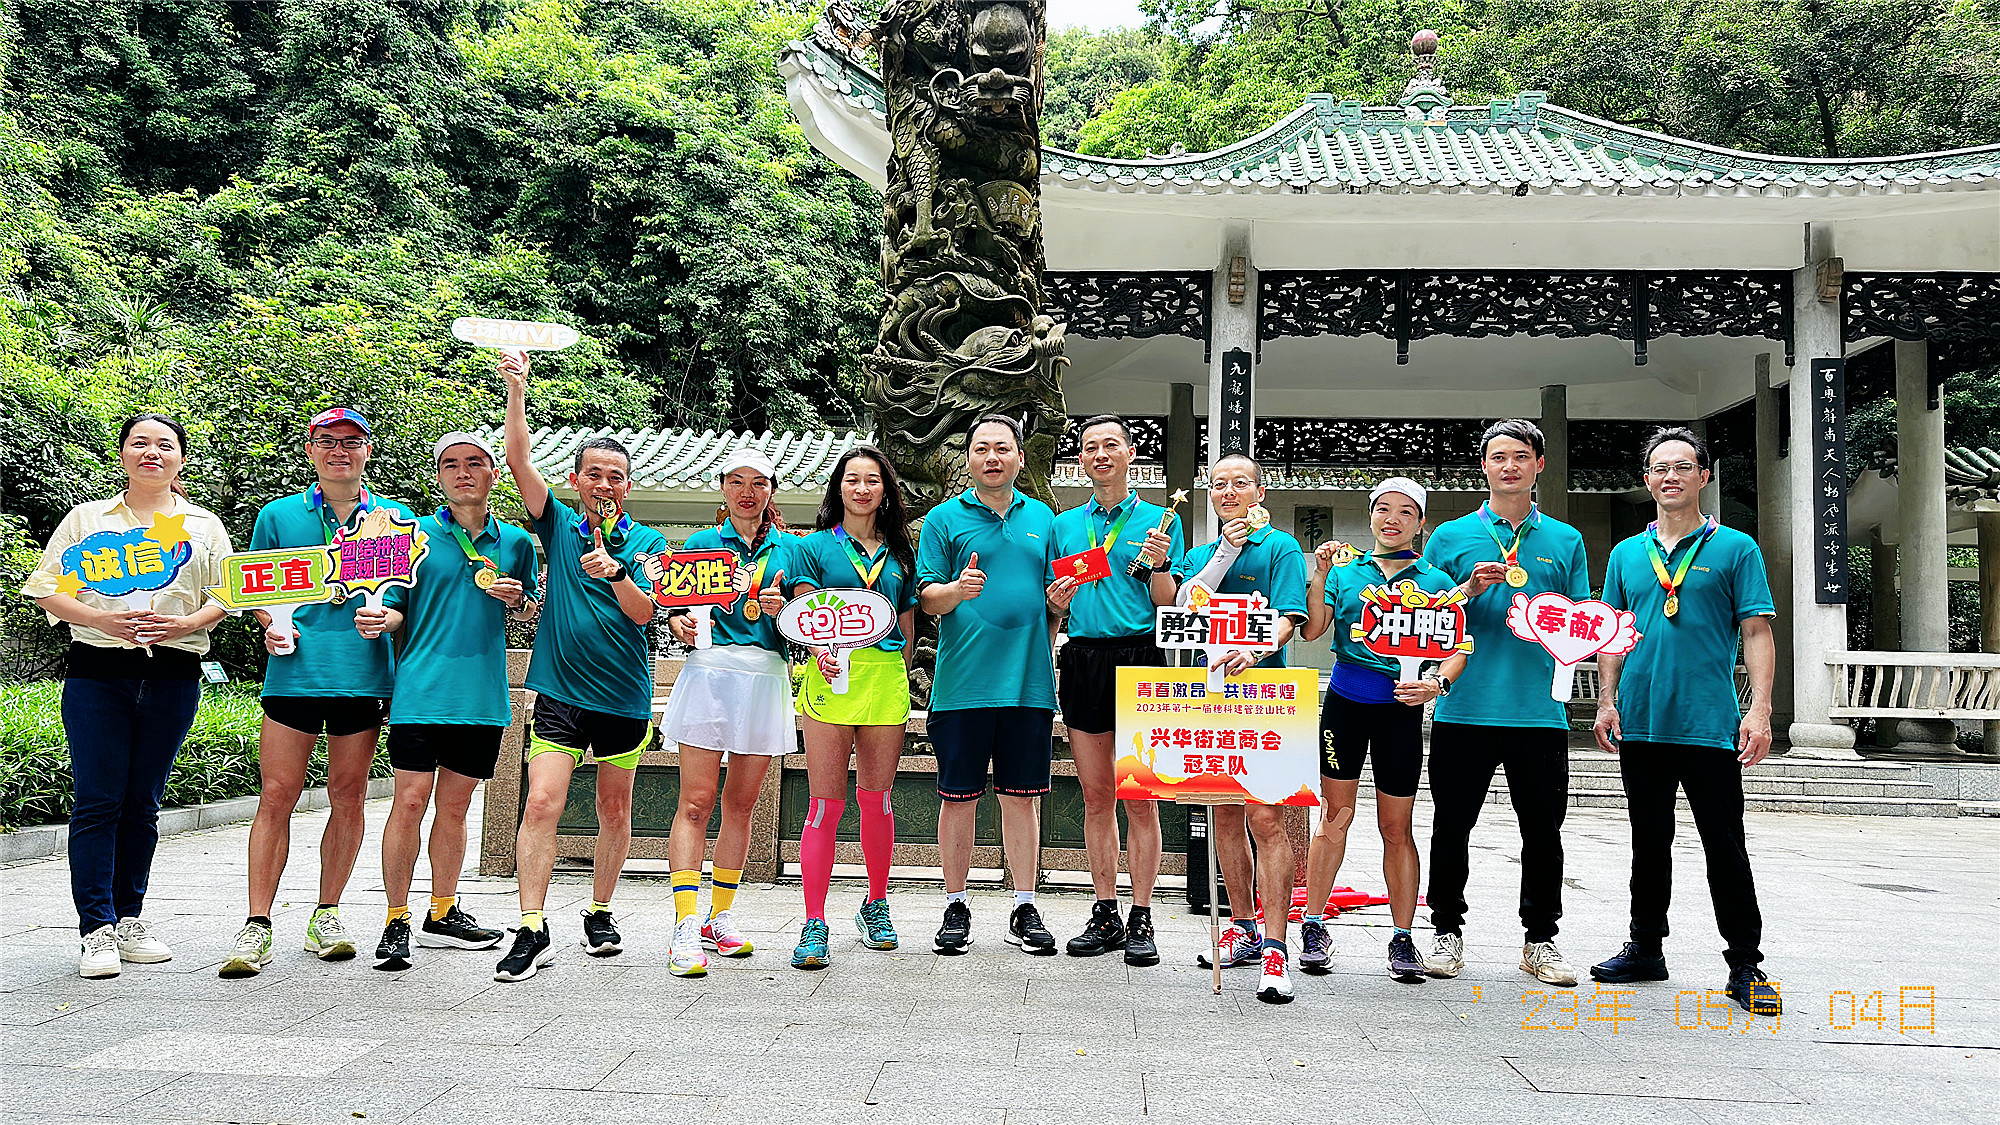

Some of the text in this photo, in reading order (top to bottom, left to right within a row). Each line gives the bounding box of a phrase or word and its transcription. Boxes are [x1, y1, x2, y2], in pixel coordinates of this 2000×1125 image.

[80, 541, 163, 584] 诚信
[340, 534, 411, 561] 团结拼搏
[240, 557, 314, 594] 正直
[340, 555, 411, 581] 展现自我
[661, 558, 734, 597] 必胜
[797, 603, 875, 640] 担当
[1161, 598, 1274, 645] 勇夺冠军
[1369, 605, 1457, 650] 冲鸭
[1535, 604, 1605, 643] 奉献
[1137, 682, 1295, 700] 青春激昂 共铸辉煌
[1150, 727, 1282, 751] 兴华街道商会
[1183, 754, 1248, 776] 冠军队
